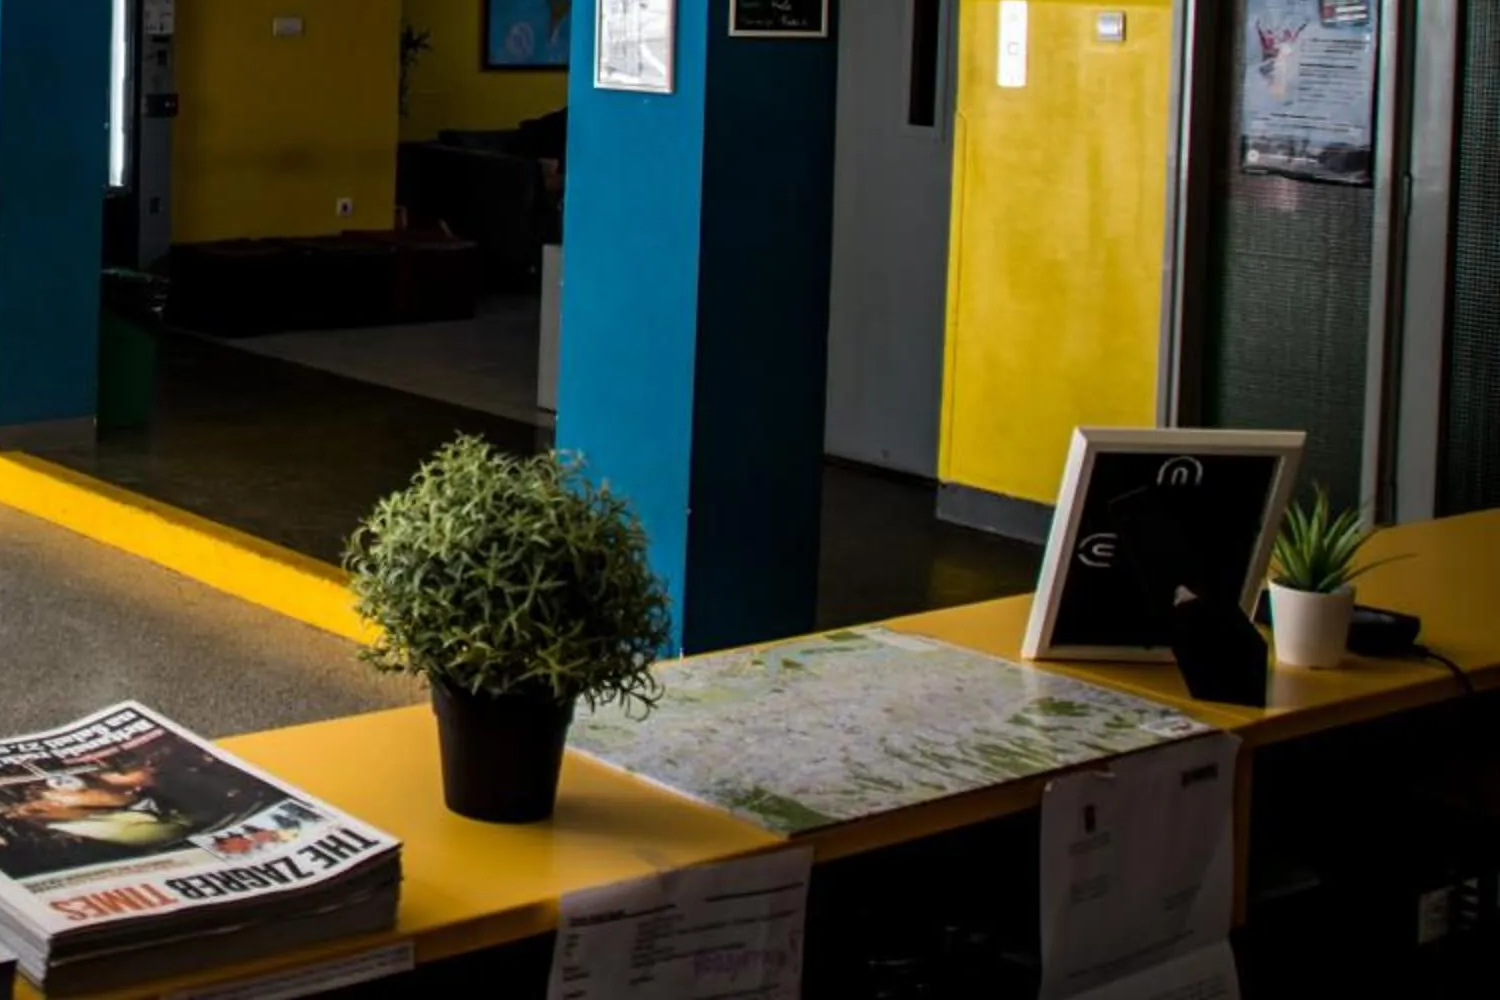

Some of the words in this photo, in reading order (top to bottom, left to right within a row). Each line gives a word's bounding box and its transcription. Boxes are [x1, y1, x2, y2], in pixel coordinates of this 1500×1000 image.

[297, 828, 380, 869] THE
[164, 855, 315, 902] ZAGREB
[48, 882, 179, 922] TIMES
